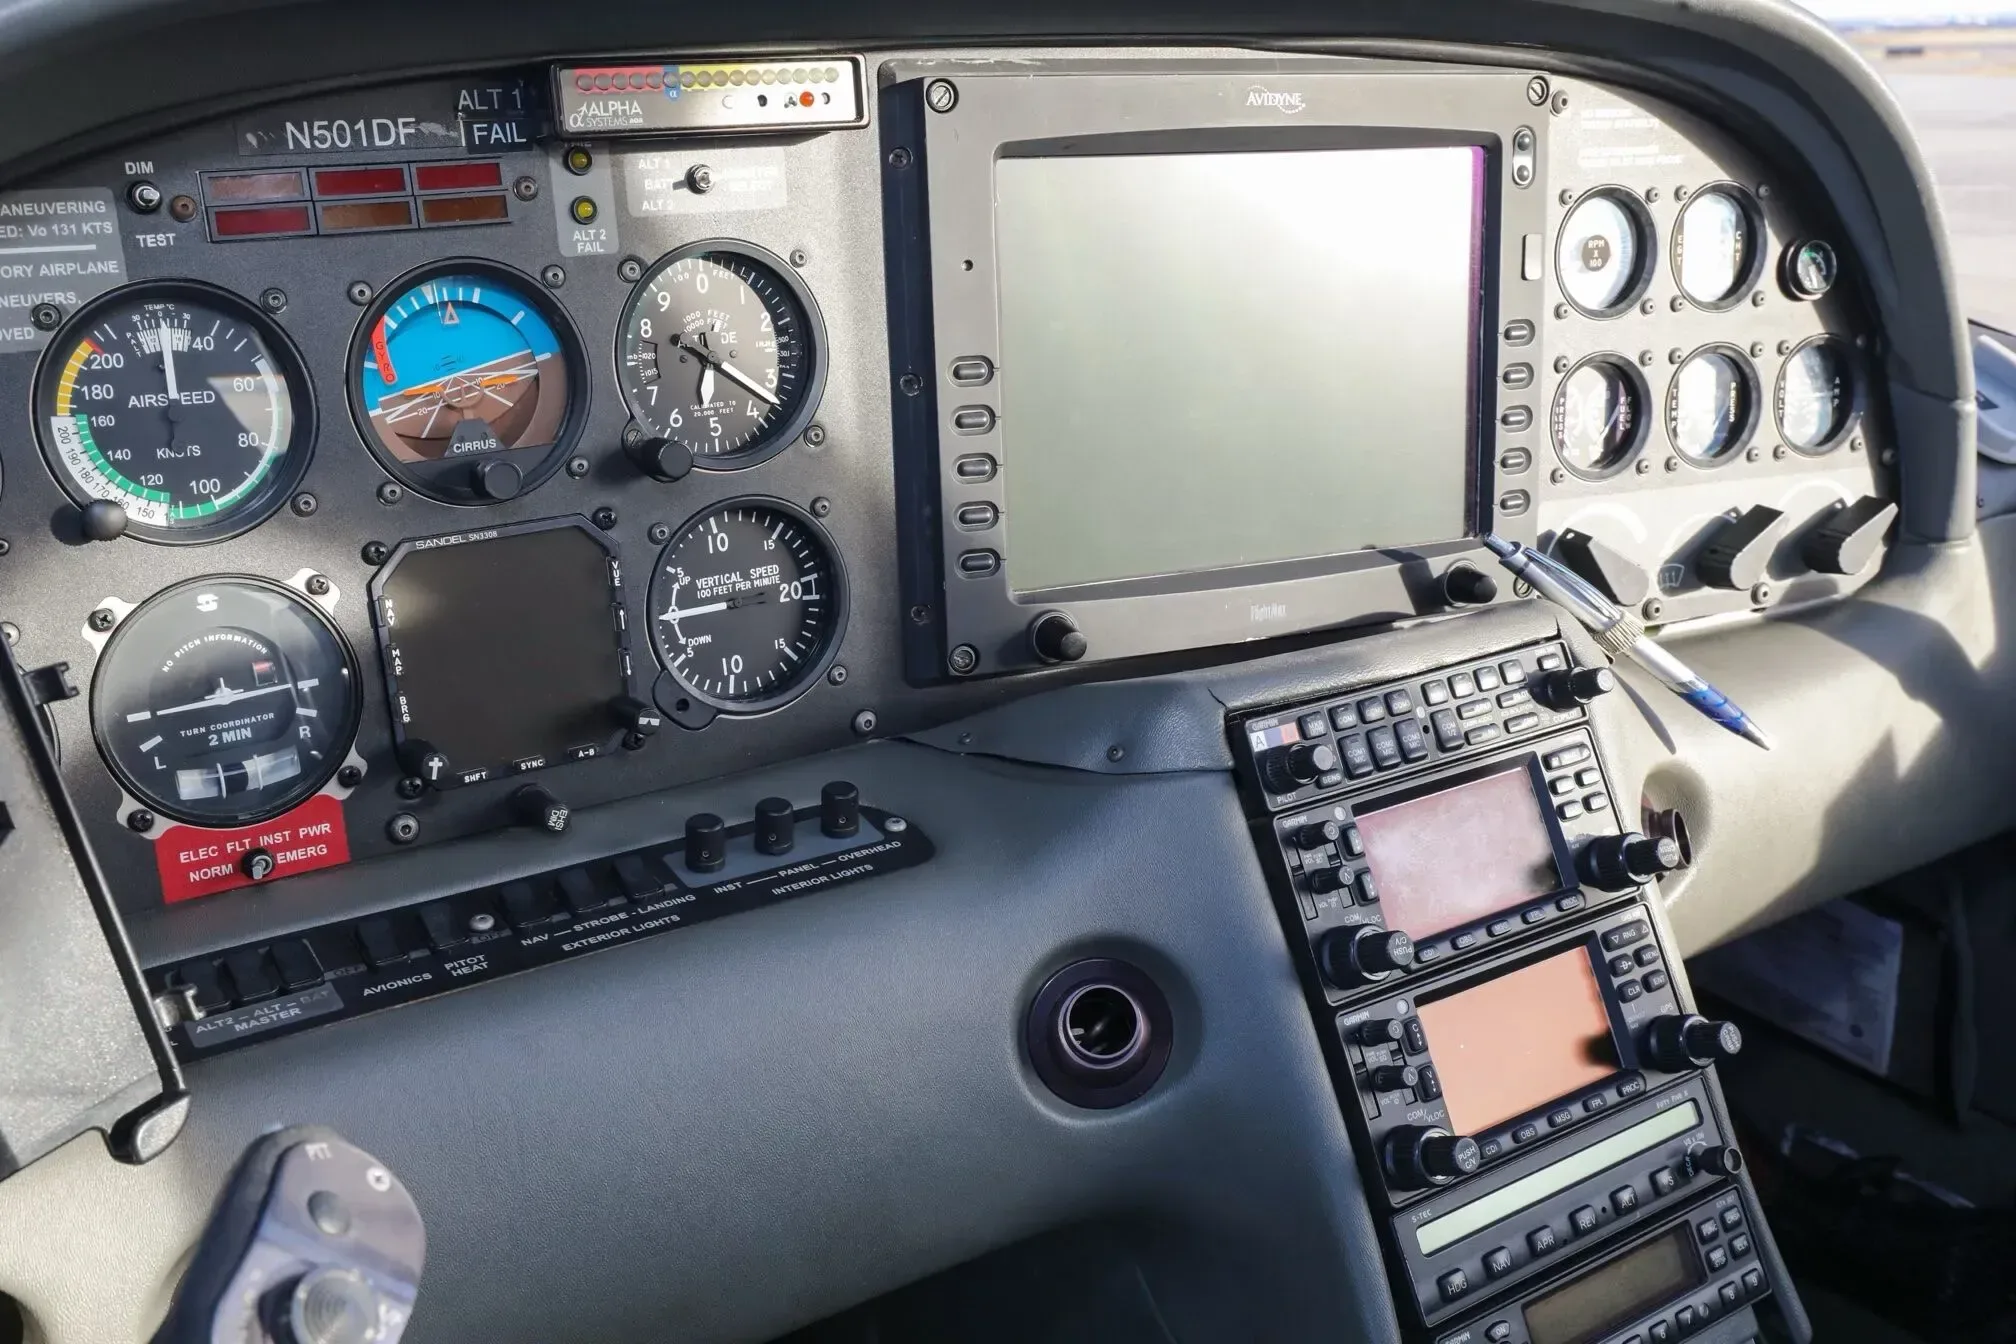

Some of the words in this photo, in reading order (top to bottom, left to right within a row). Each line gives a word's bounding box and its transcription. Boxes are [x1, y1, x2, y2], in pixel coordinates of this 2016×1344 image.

[458, 88, 502, 110] ALT
[511, 89, 522, 109] 1
[1246, 91, 1303, 106] AVIDYNE
[588, 100, 643, 117] ALPHA
[586, 117, 628, 127] SYSTEMS
[285, 117, 417, 150] N501DF
[473, 121, 527, 145] FAIL
[125, 161, 154, 175] DIM
[638, 158, 659, 170] ALT
[642, 200, 662, 211] ALT
[28, 225, 48, 237] Vo
[52, 223, 77, 236] 131
[82, 222, 113, 234] KTS
[573, 229, 596, 241] ALT
[600, 229, 607, 239] 2
[136, 233, 176, 248] TEST
[577, 241, 604, 253] FAIL
[1588, 239, 1605, 249] RPM
[39, 260, 120, 277] AIRPLANE
[713, 269, 735, 280] FEET
[696, 273, 709, 294] 0
[657, 291, 671, 312] 9
[740, 285, 745, 304] 1
[683, 310, 701, 324] 1000
[707, 309, 730, 321] FEET
[760, 312, 771, 332] 2
[640, 318, 651, 338] 8
[683, 318, 705, 333] 10000
[192, 336, 214, 351] 40
[90, 353, 124, 369] 200
[375, 341, 396, 382] GYRO
[233, 376, 254, 392] 60
[765, 368, 777, 388] 3
[81, 384, 114, 400] 180
[128, 390, 216, 408] AIRSEED
[646, 385, 658, 406] 7
[1832, 376, 1841, 407] AMP
[670, 408, 683, 427] 6
[746, 400, 760, 419] 4
[91, 414, 115, 427] 160
[709, 417, 722, 436] 5
[57, 426, 71, 445] 200
[238, 432, 259, 447] 80
[453, 438, 497, 453] CIRRUS
[67, 448, 81, 466] 190
[107, 448, 131, 461] 140
[78, 467, 93, 484] 180
[140, 473, 164, 486] 120
[93, 482, 109, 498] 170
[189, 478, 220, 495] 100
[137, 506, 155, 519] 150
[415, 534, 467, 550] SANDEL
[468, 530, 498, 541] SN3308
[708, 532, 729, 554] 10
[764, 539, 775, 550] 15
[611, 560, 621, 586] VUE
[677, 567, 684, 578] 5
[696, 571, 743, 590] VERTICAL
[750, 564, 779, 579] SPEED
[679, 576, 691, 586] UP
[697, 588, 711, 599] 100
[713, 584, 733, 596] FEET
[736, 580, 751, 592] PER
[753, 575, 780, 588] MINUTE
[780, 581, 802, 602] 20
[384, 599, 395, 626] NAV
[688, 635, 712, 648] DOWN
[775, 638, 786, 650] 15
[161, 660, 174, 673] NO
[175, 637, 201, 659] PITCH
[204, 633, 269, 654] INFORMATION
[687, 648, 694, 658] 5
[391, 649, 402, 675] MAP
[722, 655, 743, 676] 10
[399, 696, 410, 722] BRG
[180, 726, 206, 738] TURN
[210, 712, 275, 731] COORDINATOR
[299, 725, 311, 739] R
[208, 734, 219, 746] 2
[222, 727, 252, 744] MIN
[1254, 736, 1264, 749] A
[578, 747, 595, 758] A-B
[154, 756, 166, 770] L
[520, 758, 543, 770] SYNC
[464, 771, 486, 783] SHFT
[1276, 792, 1297, 804] PILOT
[547, 809, 559, 828] DIM
[554, 809, 568, 831] EHSI
[179, 845, 218, 863] ELEC
[226, 838, 252, 854] FLT
[259, 830, 291, 847] INST
[299, 823, 331, 839] PWR
[189, 863, 233, 882] NORM
[276, 844, 328, 864] EMERG
[713, 881, 742, 895] INST
[778, 862, 819, 878] PANEL
[838, 840, 902, 862] OVERHEAD
[772, 876, 828, 895] INTERIOR
[829, 864, 874, 882] LIGHTS
[521, 933, 549, 947] NAV
[572, 911, 629, 932] STROBE
[637, 894, 697, 916] LANDING
[562, 926, 631, 951] EXTERIOR
[633, 914, 680, 935] LIGHTS
[1459, 935, 1473, 945] OBS
[1623, 930, 1635, 939] RNG
[1423, 949, 1435, 958] CDI
[444, 954, 486, 971] PITOT
[451, 962, 489, 977] HEAT
[362, 972, 433, 997] AVIONICS
[1653, 976, 1665, 985] ENT
[1628, 986, 1640, 996] CLR
[195, 1016, 234, 1034] ALT2
[254, 1003, 281, 1017] ALT
[233, 1007, 302, 1032] MASTER
[1343, 1010, 1370, 1026] GARMIN
[1412, 1023, 1419, 1032] C
[1622, 1082, 1640, 1096] PROC
[1591, 1098, 1604, 1109] FPL
[1555, 1111, 1571, 1123] MSG
[1520, 1127, 1535, 1140] OBS
[1458, 1145, 1476, 1162] PUSH
[1485, 1144, 1498, 1156] CDI
[1621, 1192, 1637, 1208] ALT
[1411, 1208, 1433, 1224] S-TEC
[1579, 1213, 1597, 1230] REV
[1536, 1236, 1555, 1252] APR
[1493, 1257, 1512, 1272] NAV
[1447, 1280, 1468, 1295] HDG
[1753, 1276, 1758, 1286] 9
[1728, 1290, 1735, 1300] 8
[1660, 1330, 1666, 1339] 6
